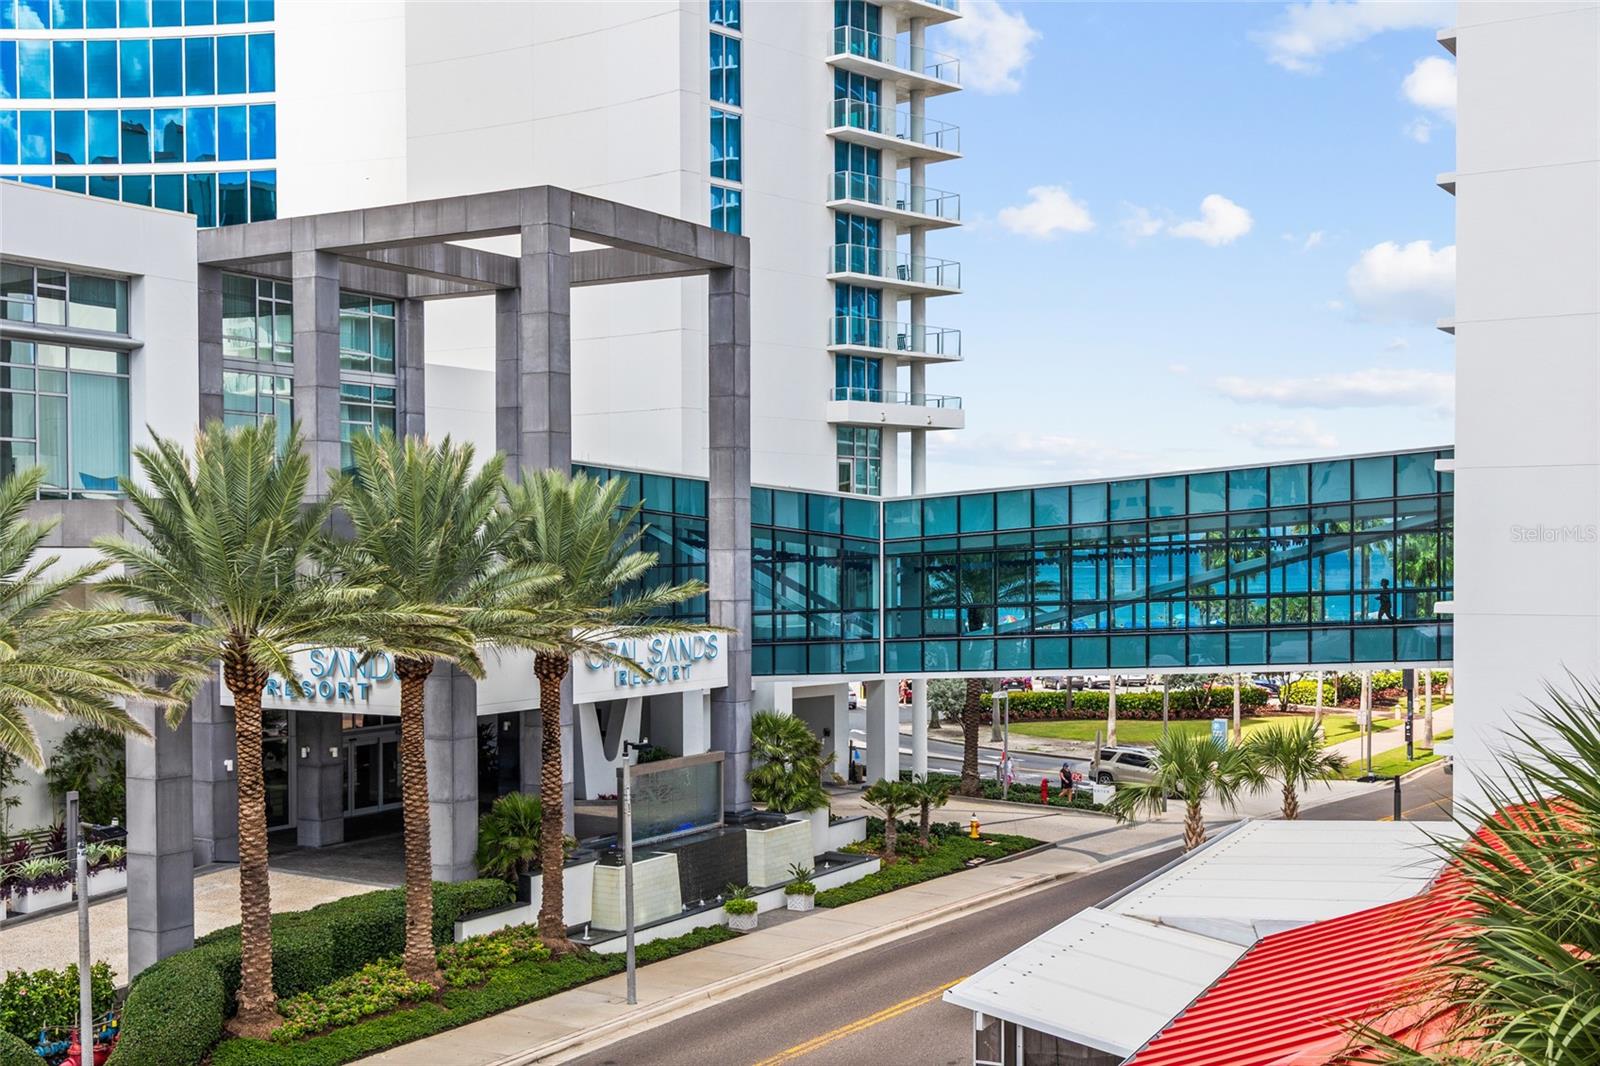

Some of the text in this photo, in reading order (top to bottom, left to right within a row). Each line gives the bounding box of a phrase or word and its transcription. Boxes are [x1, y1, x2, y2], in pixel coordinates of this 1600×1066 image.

[649, 634, 719, 665] SANDS
[309, 649, 401, 681] SAND
[615, 664, 692, 687] RESORT
[266, 678, 370, 701] RESORT
